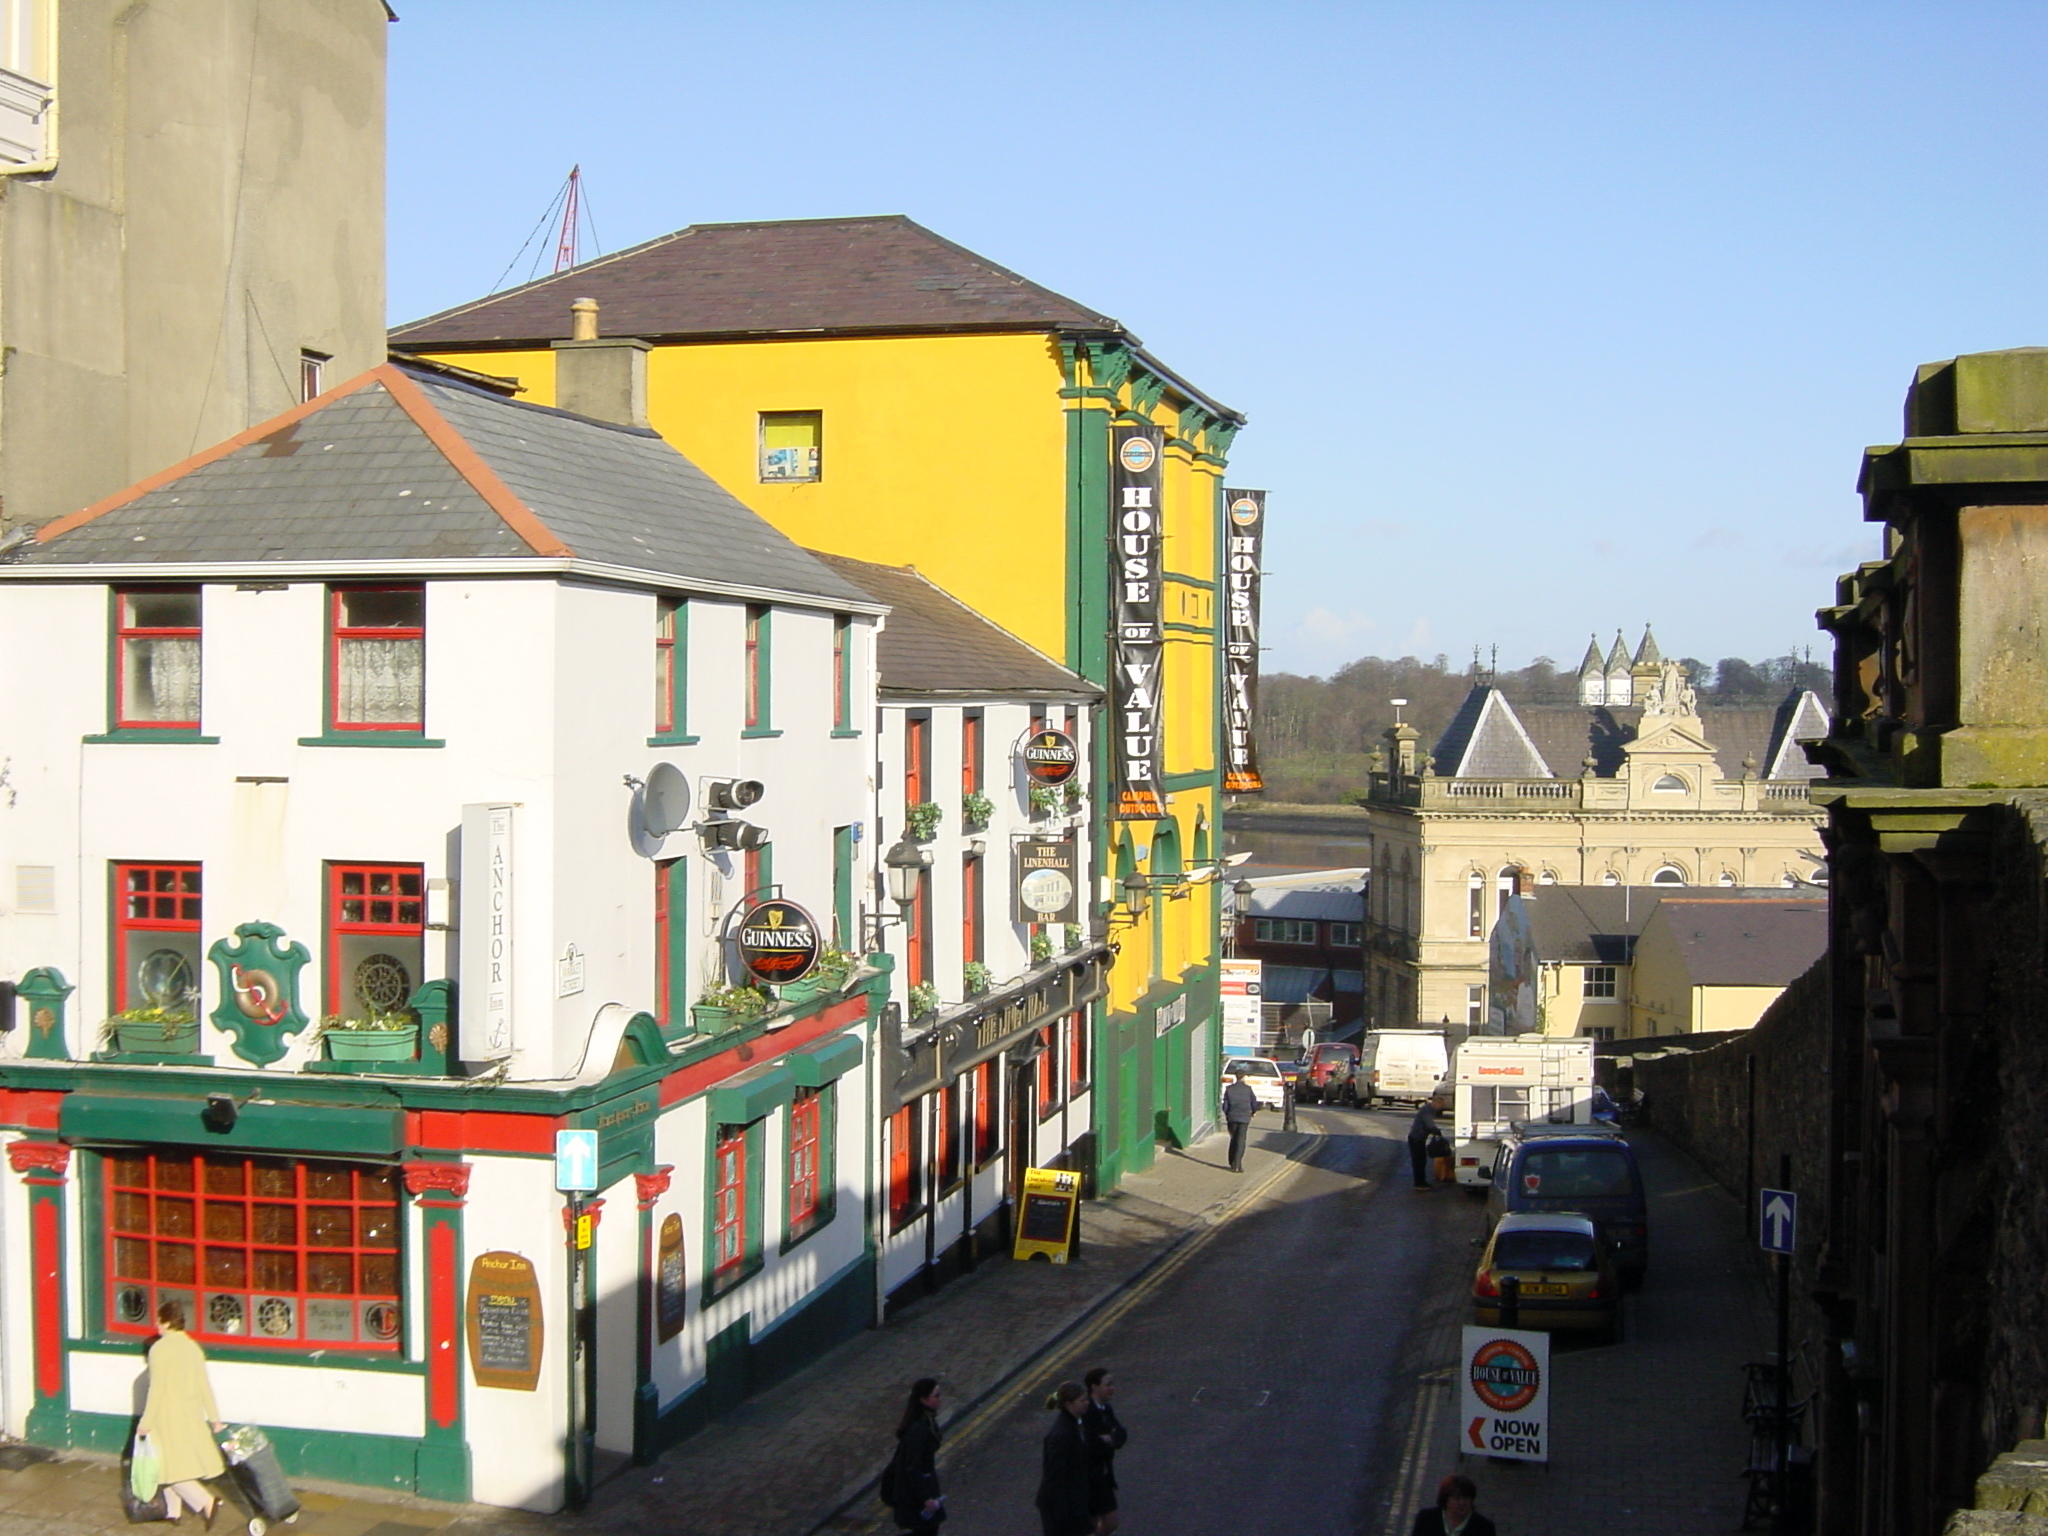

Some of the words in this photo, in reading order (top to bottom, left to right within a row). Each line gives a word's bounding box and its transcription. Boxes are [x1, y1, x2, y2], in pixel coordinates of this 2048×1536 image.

[1122, 486, 1152, 603] HOUSE
[1230, 536, 1254, 626] HOUSE
[1125, 627, 1150, 638] OF
[1229, 645, 1249, 655] OF
[1124, 664, 1152, 781] VALUE
[1230, 674, 1248, 765] VALUE
[1026, 747, 1075, 761] GUINNESS
[1036, 847, 1056, 857] THE
[491, 844, 504, 983] ANCHOR
[1037, 912, 1056, 922] BAR
[742, 928, 813, 948] GUINNESS
[1473, 1365, 1500, 1380] HOUSE
[1510, 1370, 1537, 1385] VALUE
[1494, 1418, 1540, 1437] NOW
[1490, 1435, 1540, 1454] OPEN
